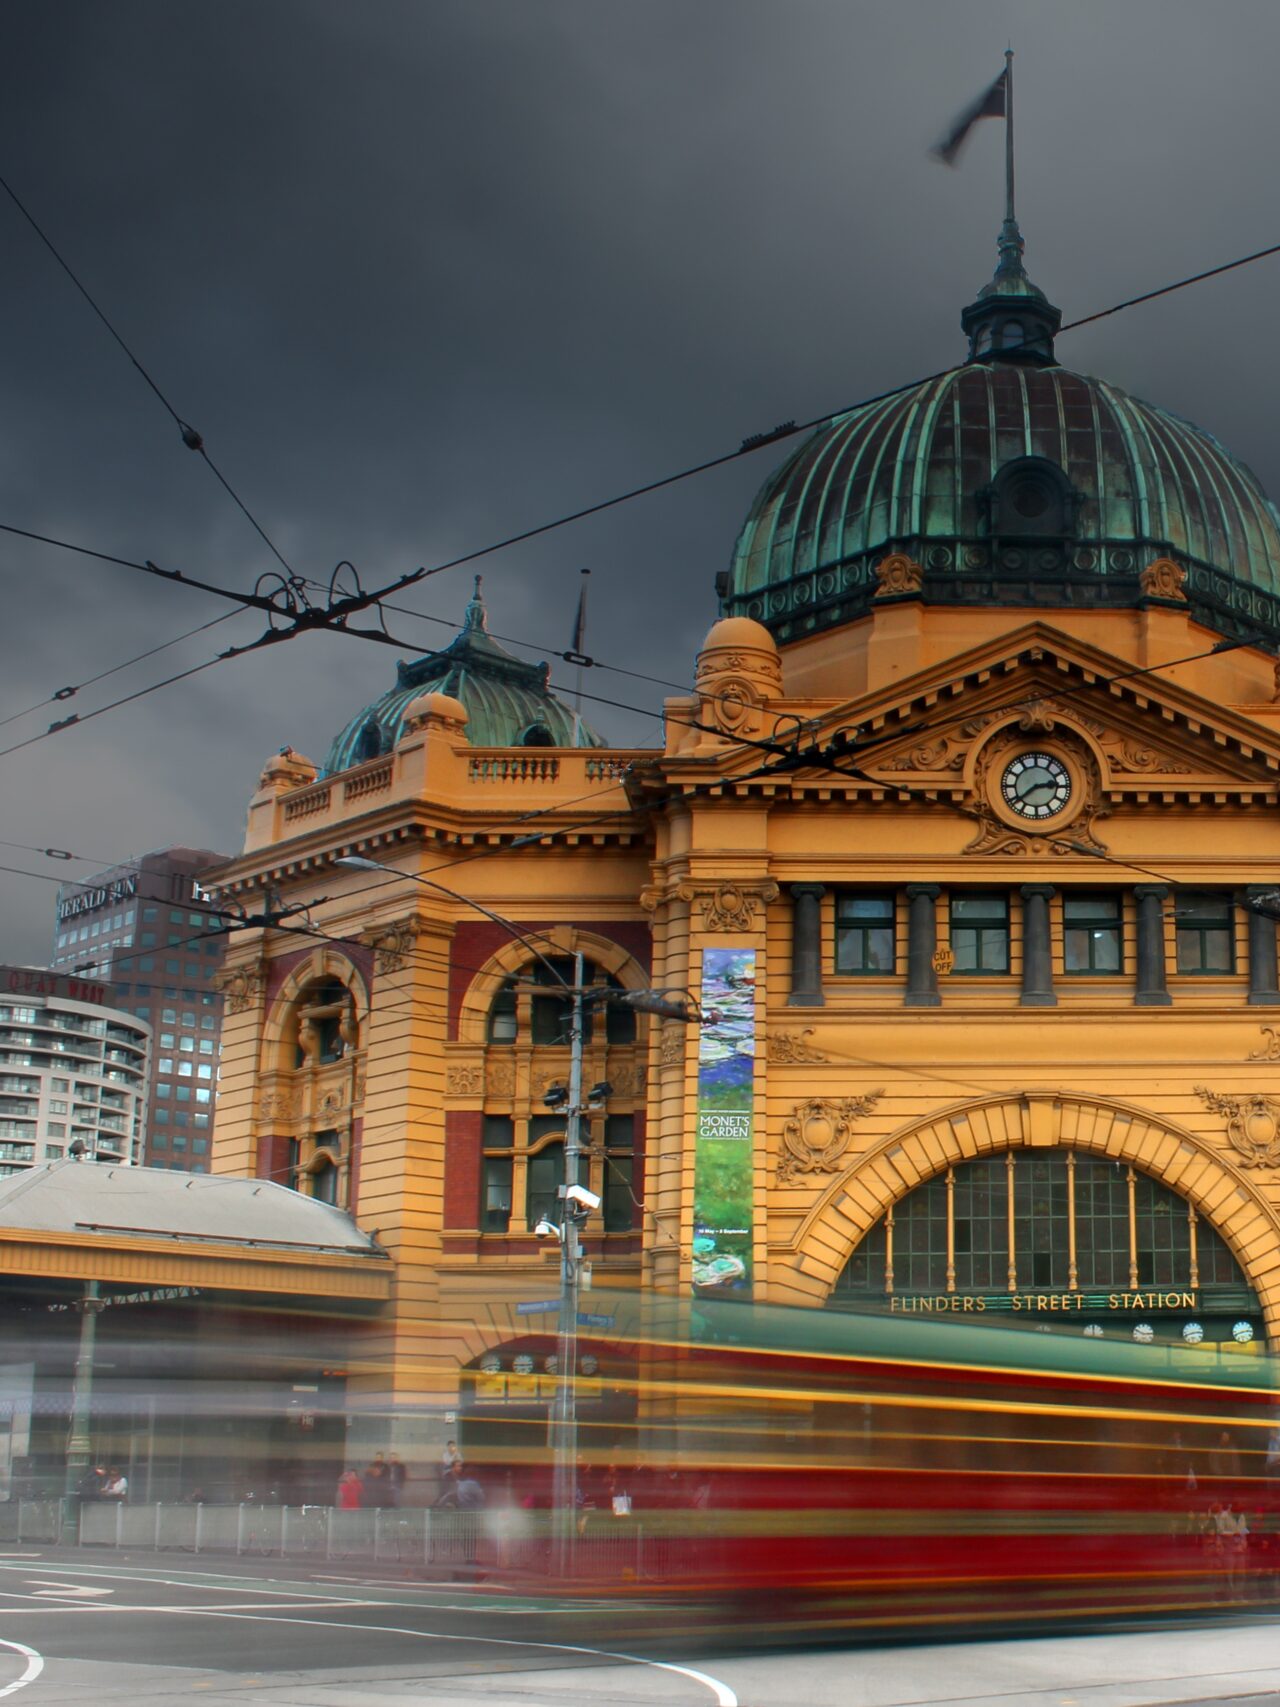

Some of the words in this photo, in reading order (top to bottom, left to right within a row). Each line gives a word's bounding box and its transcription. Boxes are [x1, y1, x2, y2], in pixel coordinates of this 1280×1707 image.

[59, 890, 105, 918] HERALD
[110, 878, 136, 900] SUN
[934, 951, 951, 961] CUT
[935, 962, 952, 972] OFF
[9, 971, 56, 993] QUAY
[68, 980, 104, 1003] WEST
[700, 1116, 750, 1127] MONET'S
[700, 1127, 749, 1137] GARDEN
[890, 1296, 987, 1312] FLINDERS
[1012, 1295, 1085, 1311] STREET
[1108, 1292, 1197, 1309] STATION
